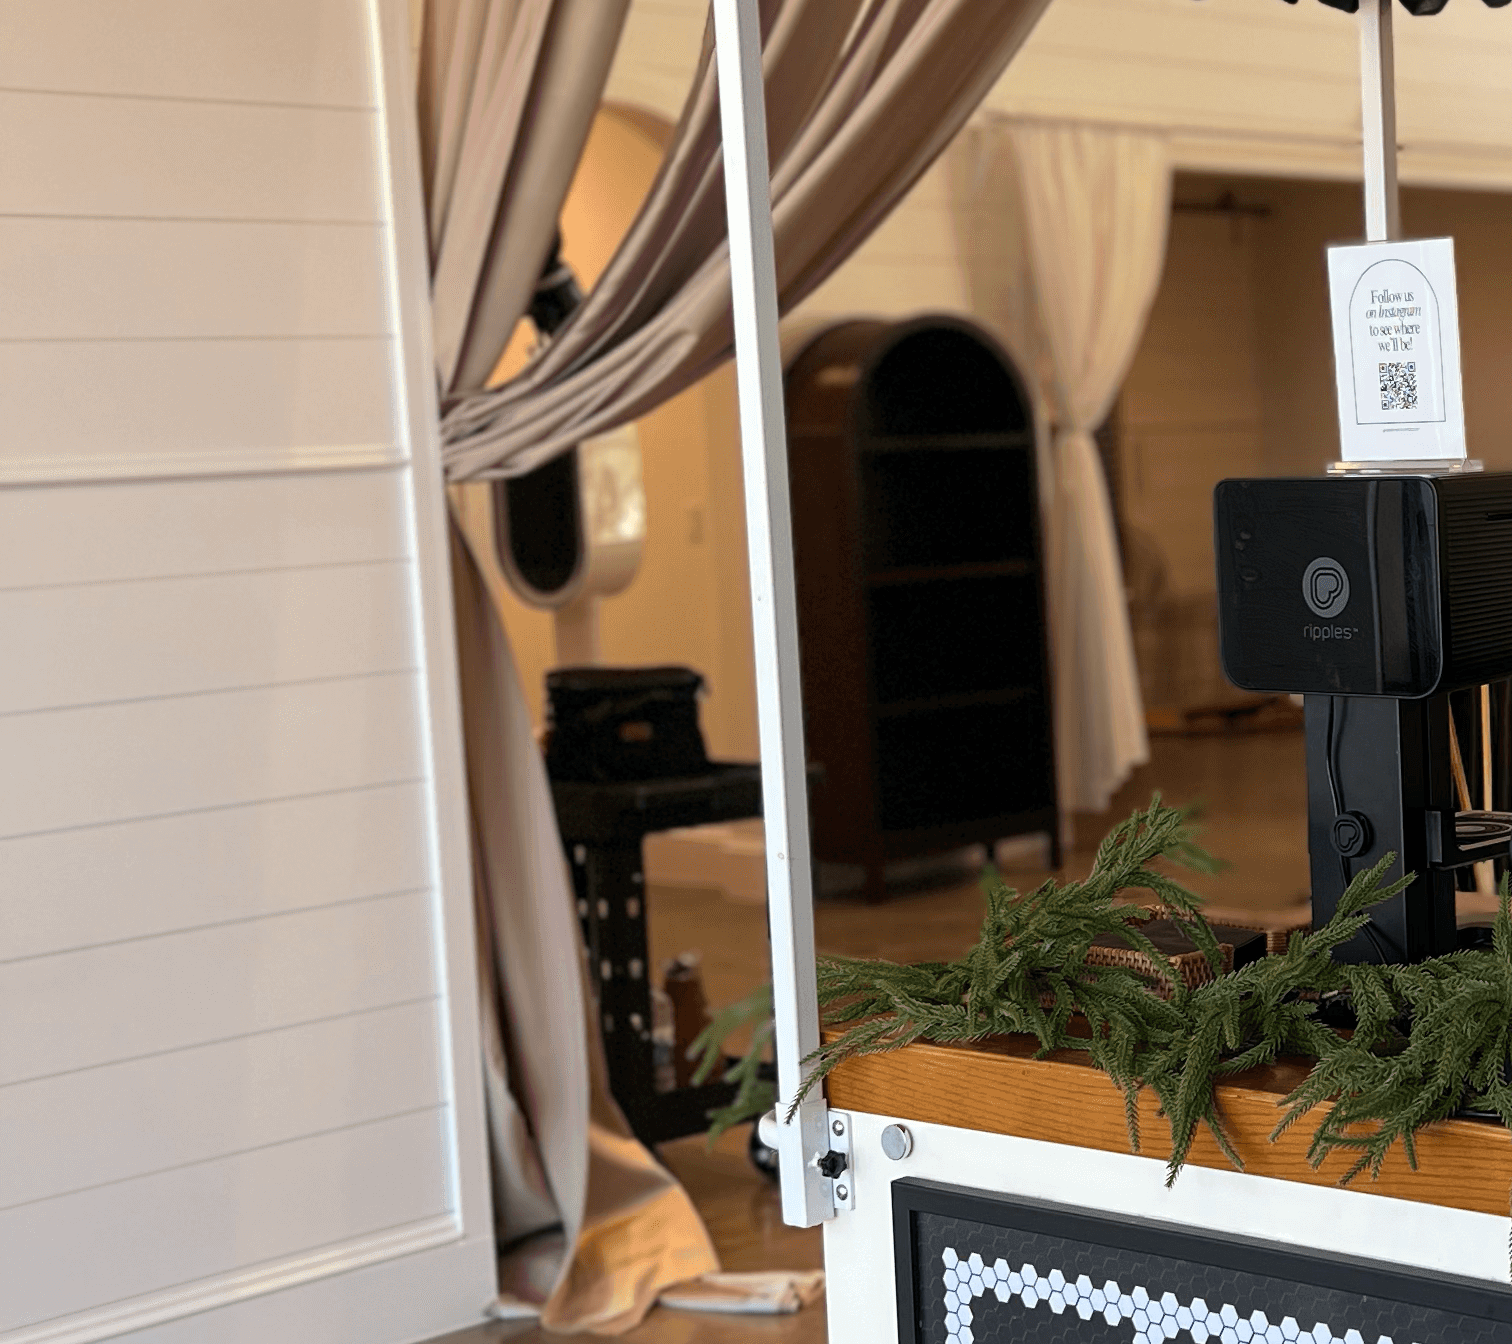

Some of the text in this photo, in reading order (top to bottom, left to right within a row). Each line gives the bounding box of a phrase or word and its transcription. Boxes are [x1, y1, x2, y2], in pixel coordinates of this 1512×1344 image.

[1370, 289, 1414, 304] Follow us
[1365, 305, 1422, 321] on Instagram
[1369, 321, 1421, 336] to see where
[1400, 337, 1413, 351] be!
